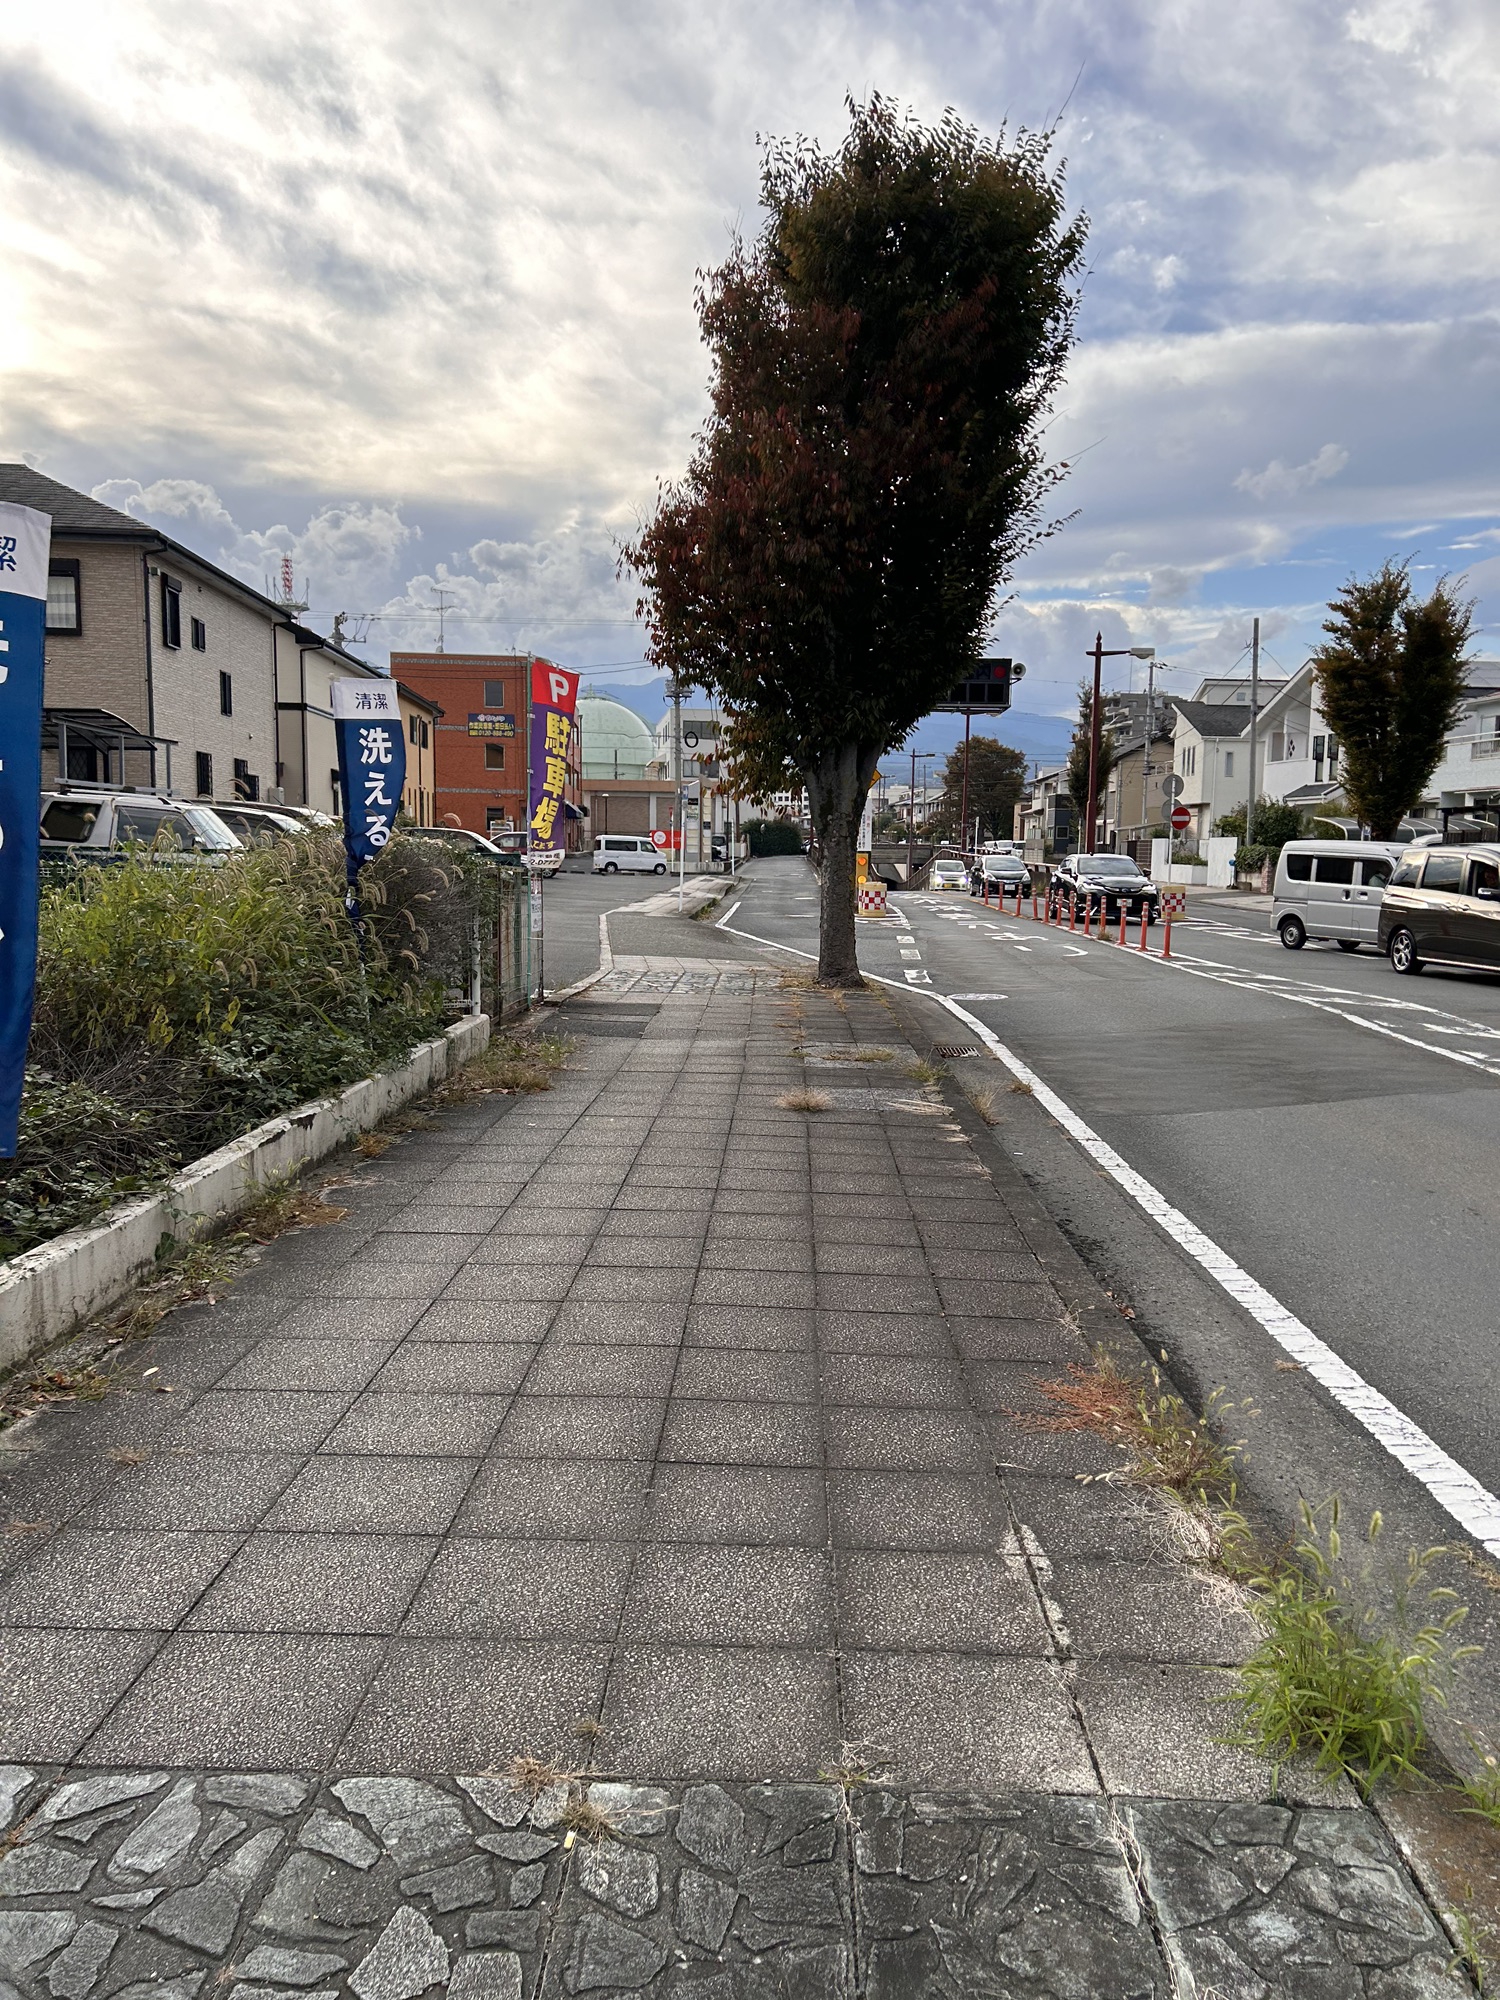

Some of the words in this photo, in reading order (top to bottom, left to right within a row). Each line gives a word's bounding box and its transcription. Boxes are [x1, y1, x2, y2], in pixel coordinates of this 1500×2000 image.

[355, 692, 388, 710] 清潔
[548, 672, 569, 703] P
[359, 727, 392, 861] 洗える
[531, 711, 571, 840] 駐車場
